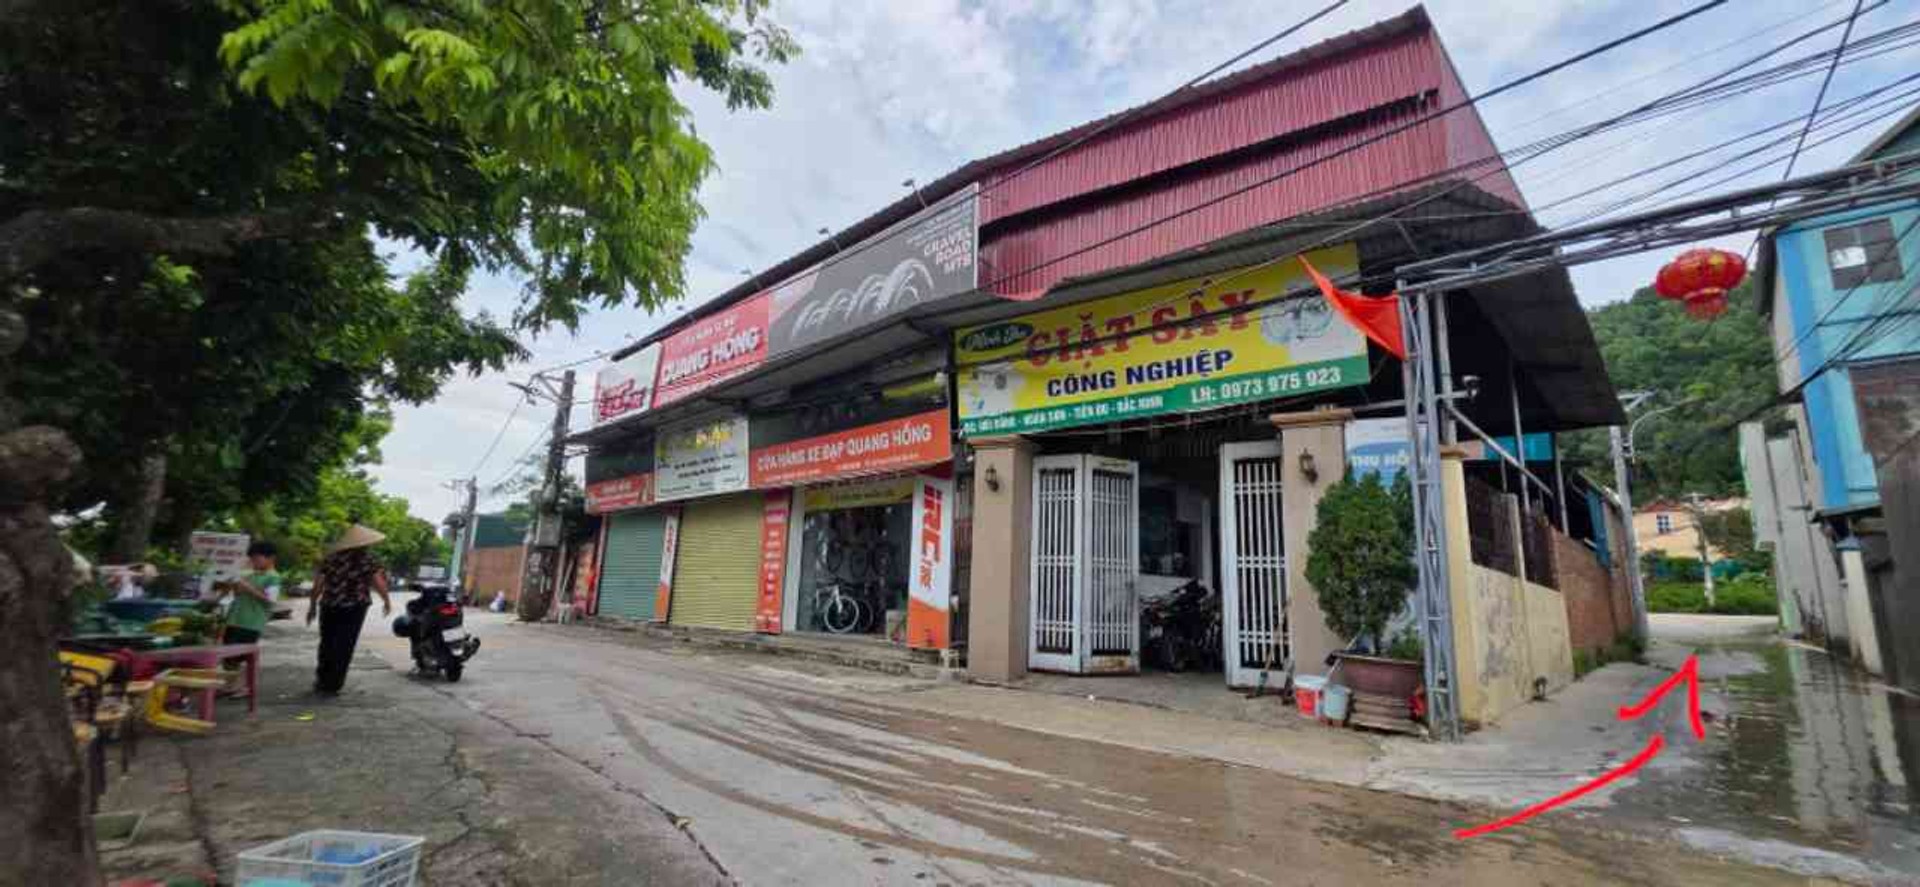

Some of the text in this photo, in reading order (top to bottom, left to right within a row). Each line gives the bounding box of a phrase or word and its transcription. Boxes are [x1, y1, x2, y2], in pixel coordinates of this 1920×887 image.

[1028, 311, 1106, 369] GIẶT
[1047, 348, 1234, 397] CÔNG NGHIỆP
[1191, 367, 1342, 403] LH: 0973 975 923
[847, 433, 889, 455] QUANG
